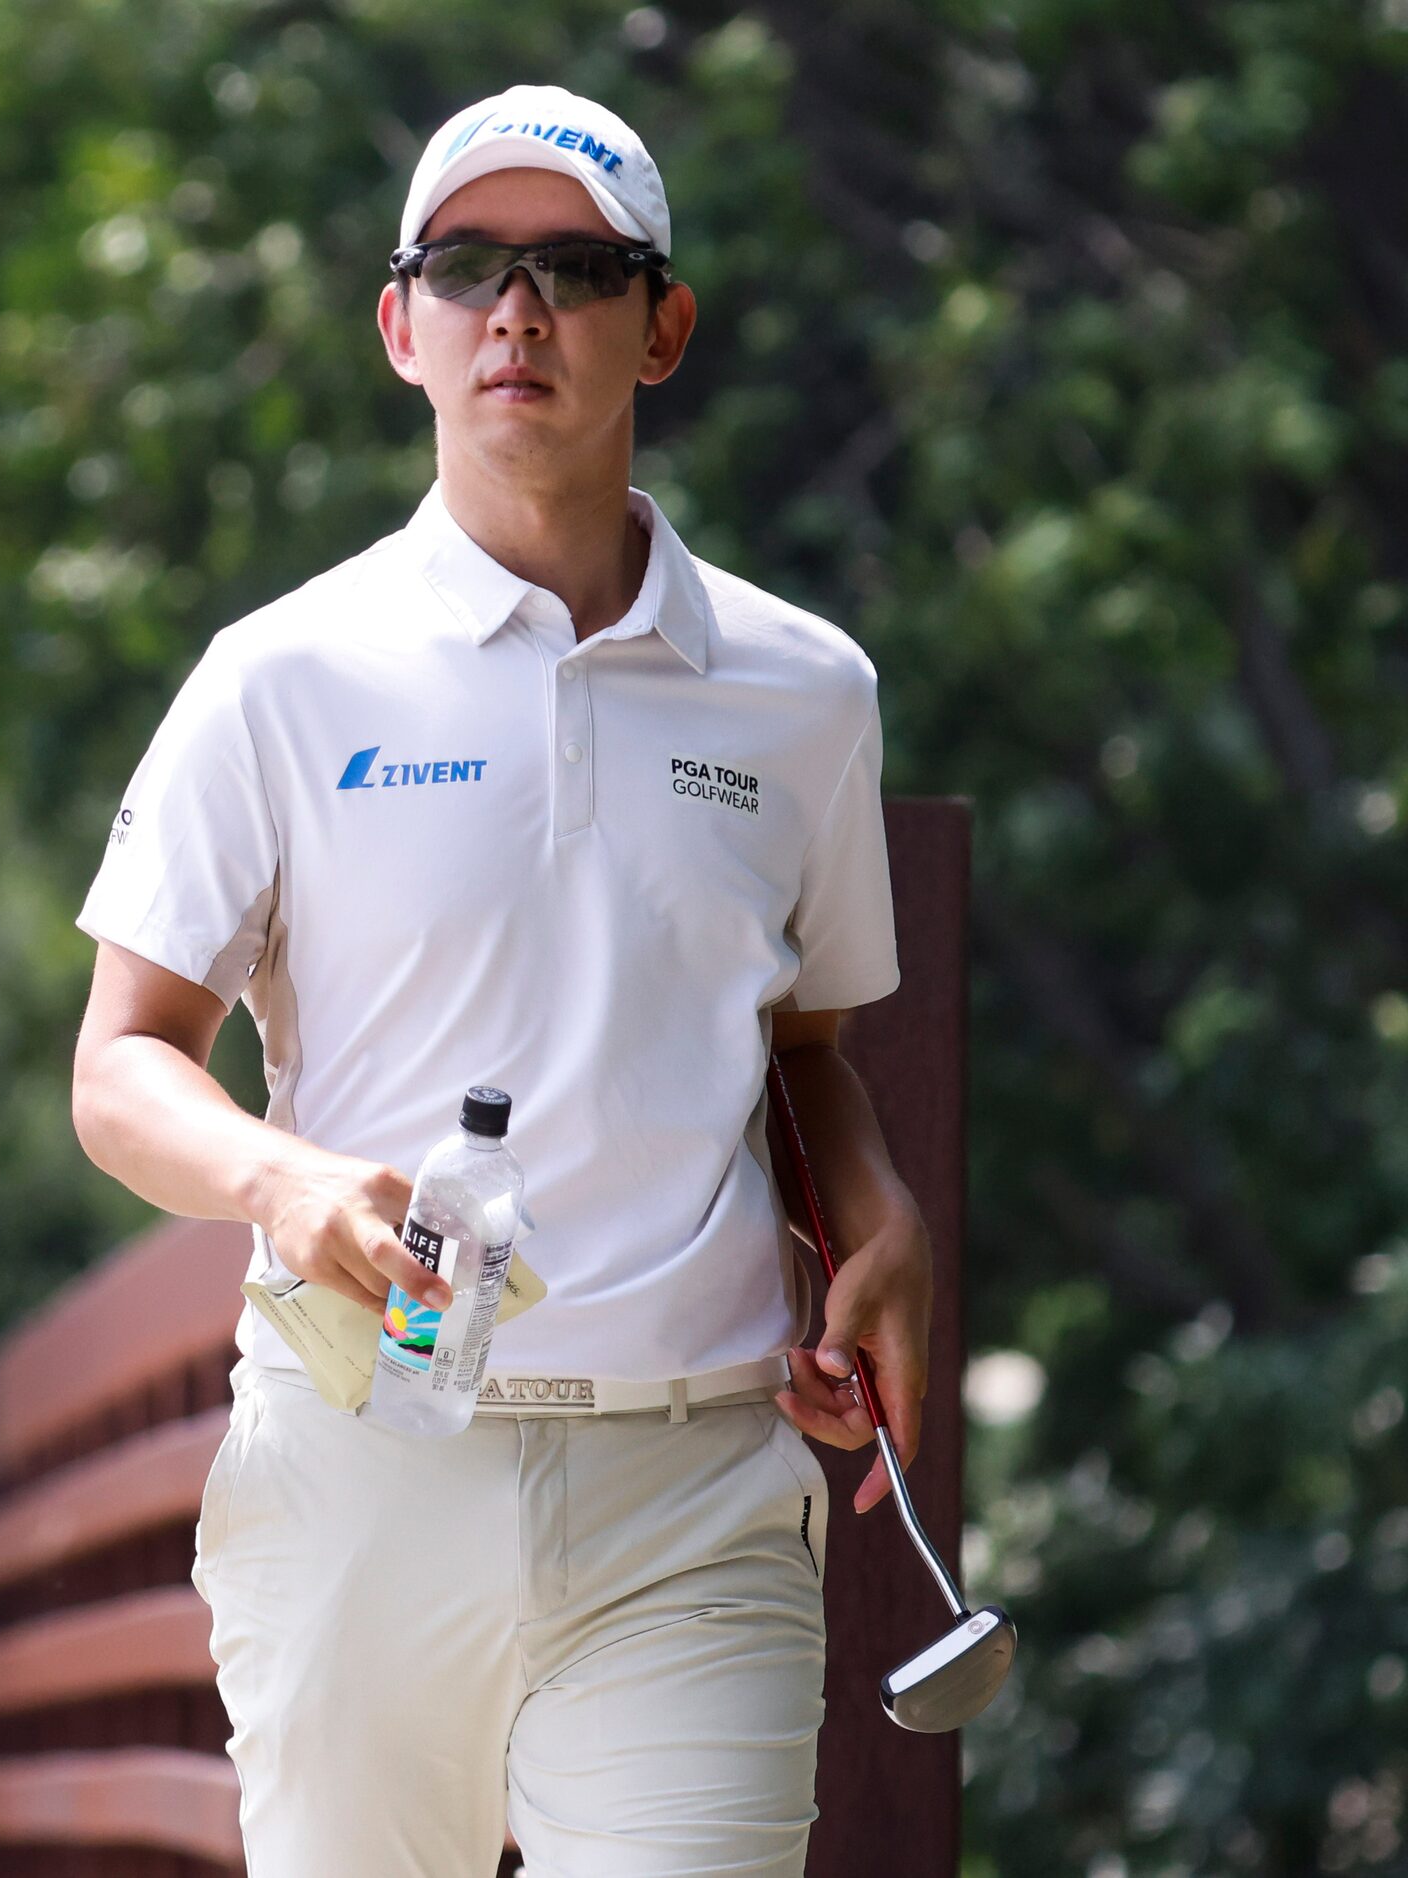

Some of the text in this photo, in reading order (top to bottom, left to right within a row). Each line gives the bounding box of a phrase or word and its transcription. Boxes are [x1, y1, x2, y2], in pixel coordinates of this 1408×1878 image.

[382, 760, 487, 787] ZIVENT
[671, 758, 759, 795] PGA TOUR
[672, 779, 759, 815] GOLFWEAR
[405, 1226, 439, 1255] LIFE
[507, 1378, 595, 1401] TOUR
